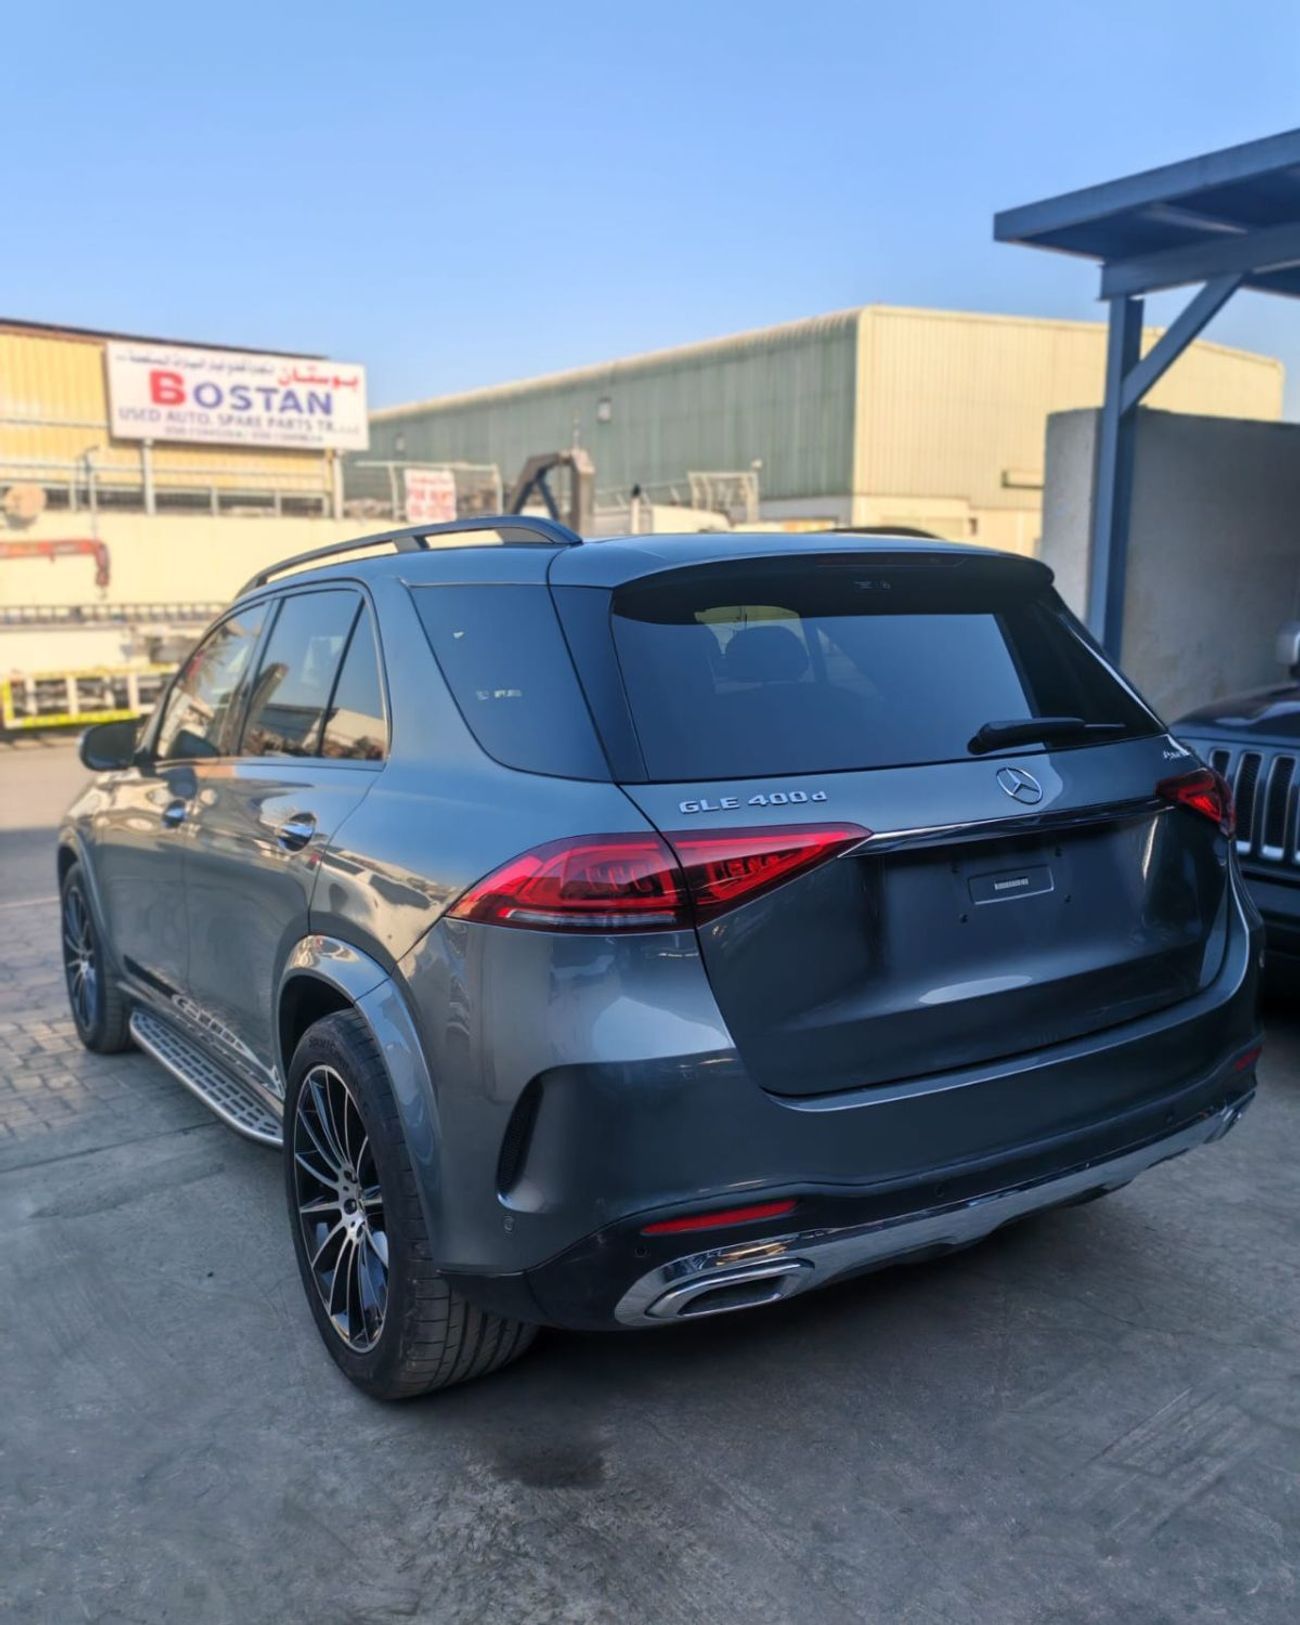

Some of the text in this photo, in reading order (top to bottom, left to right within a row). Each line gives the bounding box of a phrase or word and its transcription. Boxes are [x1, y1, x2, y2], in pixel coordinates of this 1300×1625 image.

[149, 369, 333, 416] BOSTAN
[118, 407, 161, 421] USED
[218, 414, 262, 430] SPARE
[267, 417, 312, 432] PARTS
[679, 797, 740, 813] GLE
